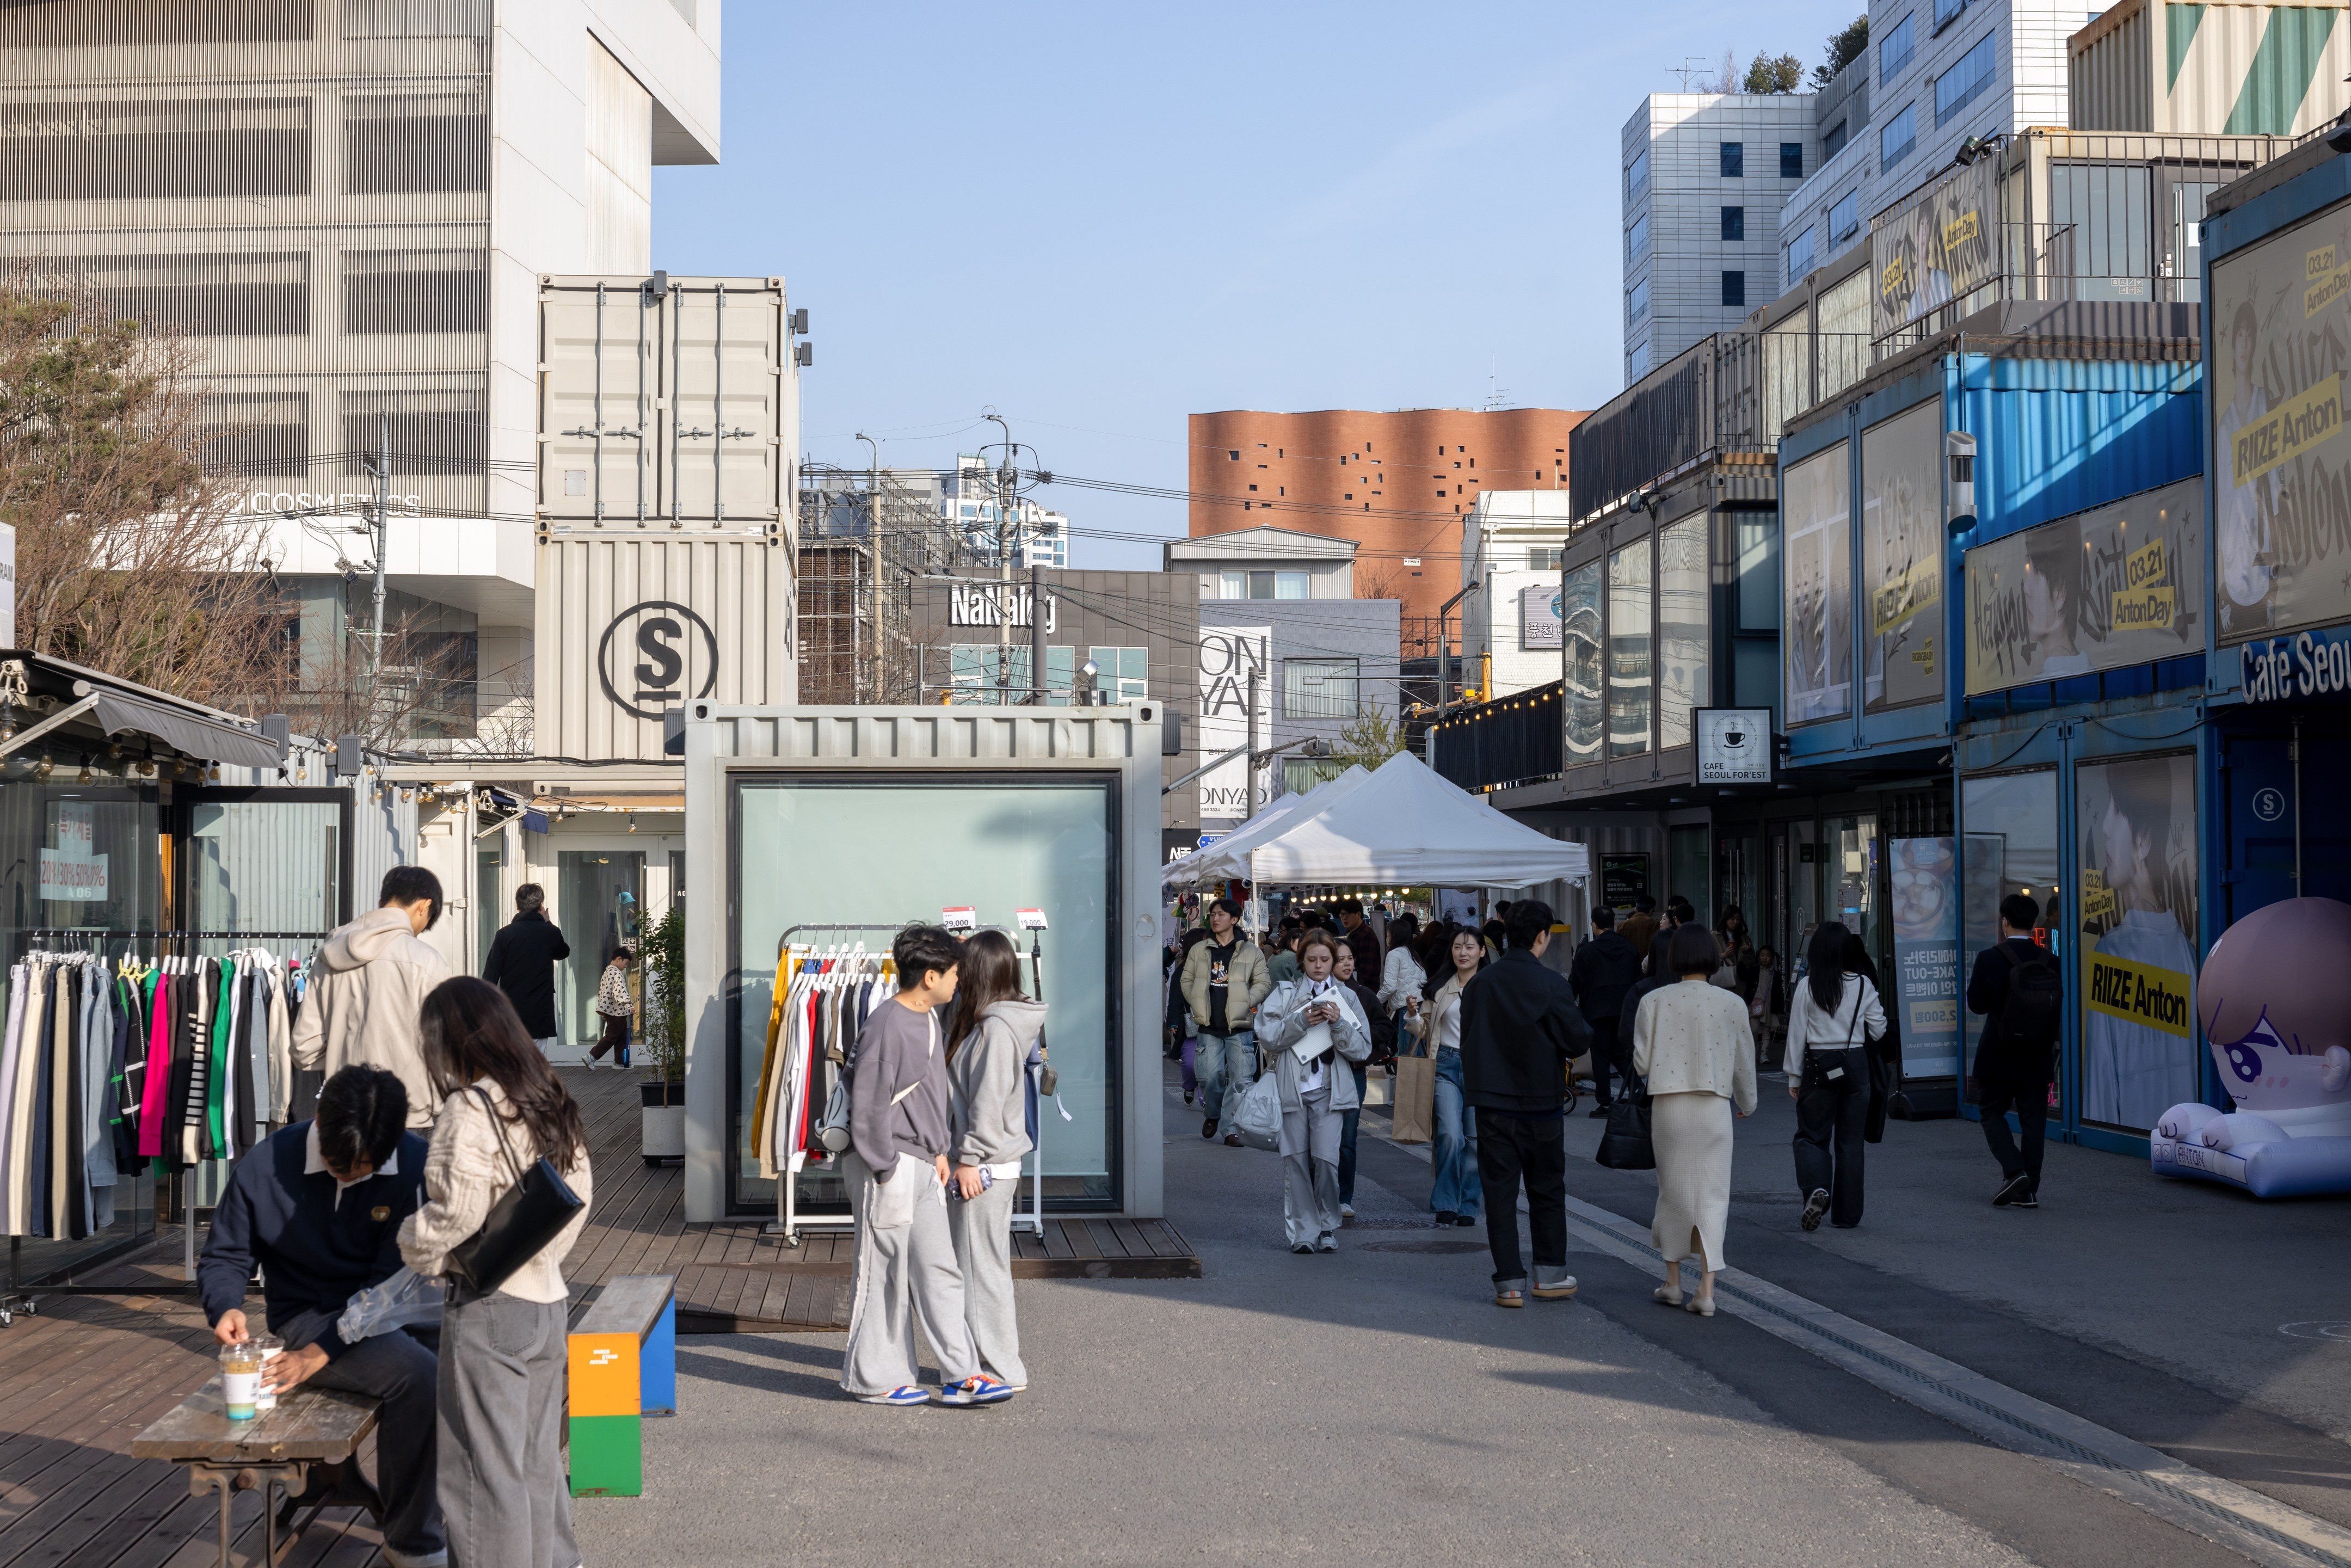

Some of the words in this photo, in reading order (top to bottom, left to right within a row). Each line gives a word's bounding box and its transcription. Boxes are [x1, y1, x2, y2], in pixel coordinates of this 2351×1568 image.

[1884, 261, 1903, 291] 03.21
[2309, 251, 2333, 275] 03.21
[2238, 418, 2279, 478] RIIZE
[2282, 397, 2337, 453] Anton
[2130, 545, 2163, 587] 03.21
[2239, 638, 2291, 704] Cafe
[2085, 872, 2101, 888] 03.21
[2091, 963, 2132, 1011] RIIZE
[2133, 974, 2186, 1027] Anton
